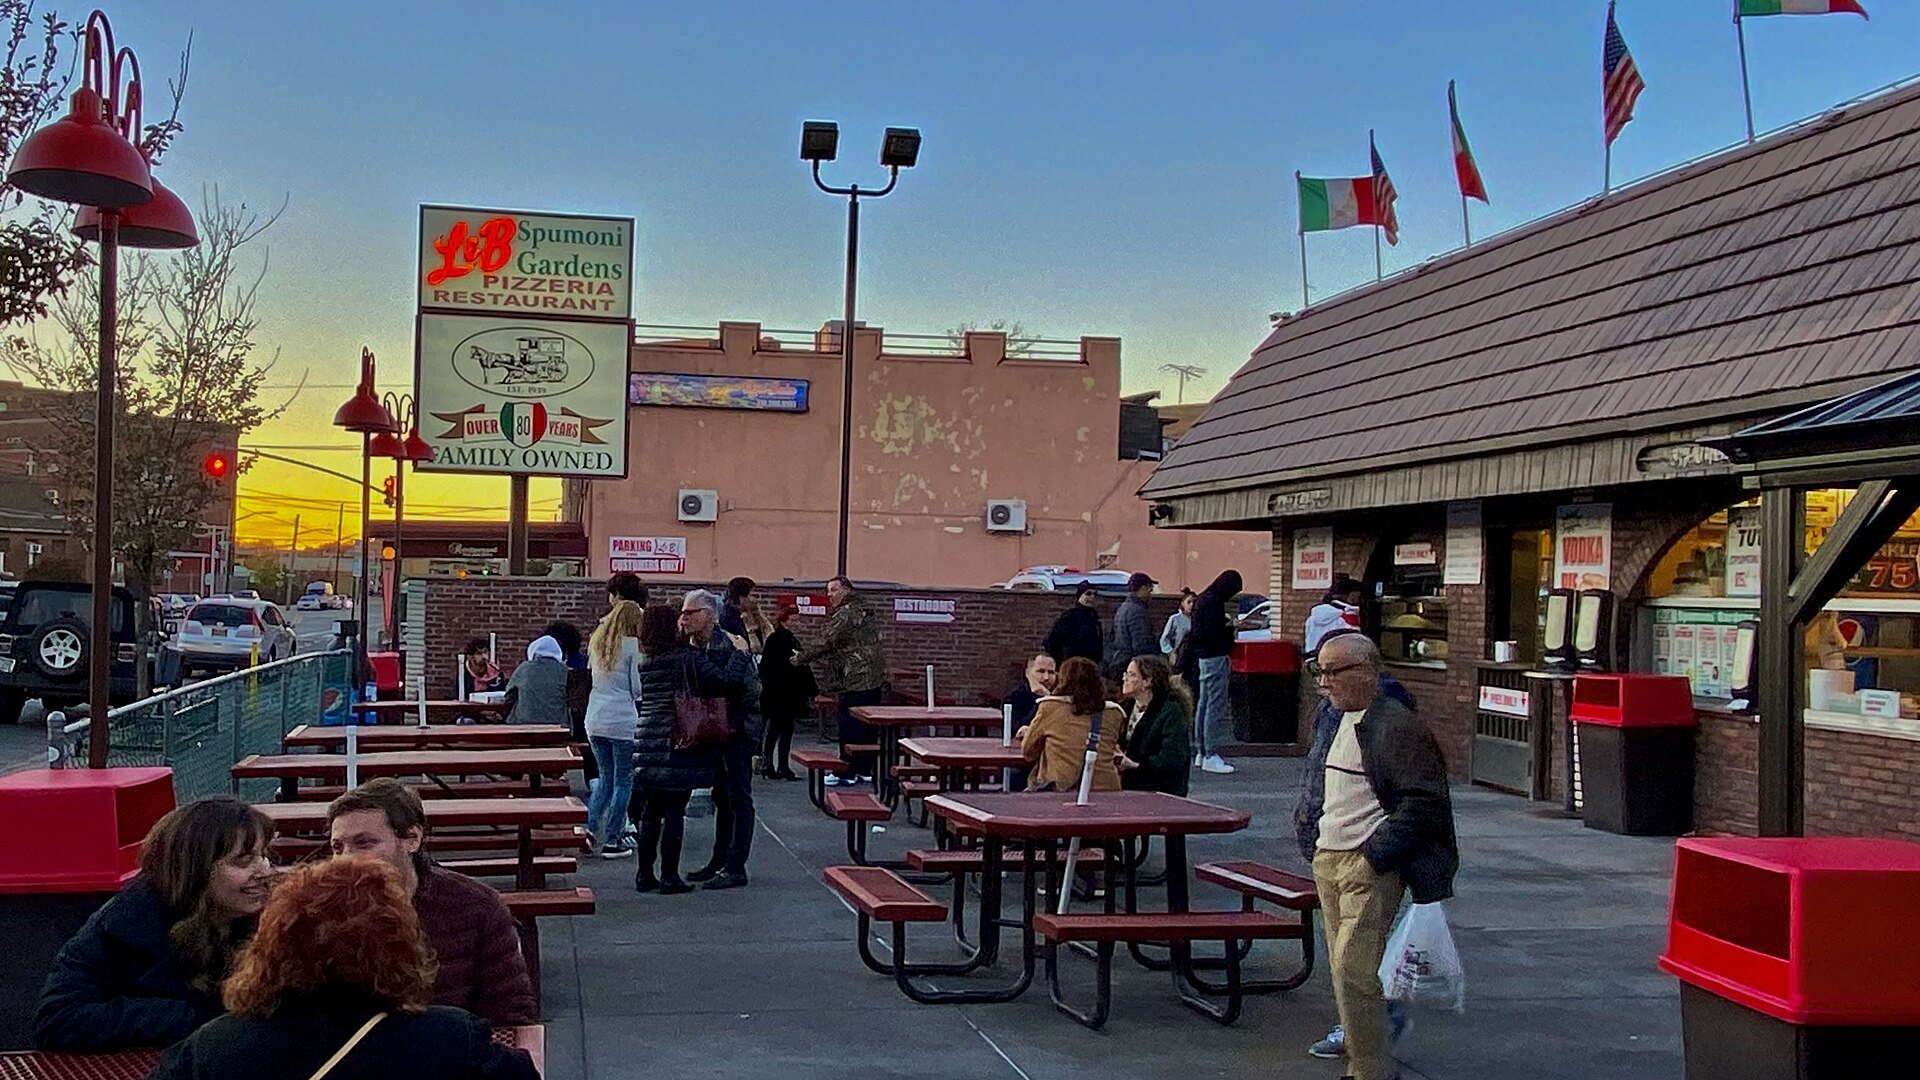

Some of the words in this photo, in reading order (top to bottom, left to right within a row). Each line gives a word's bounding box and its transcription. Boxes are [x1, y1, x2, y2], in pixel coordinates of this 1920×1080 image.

[518, 219, 623, 249] Spumoni
[517, 251, 622, 280] Gardens
[483, 275, 615, 296] PIZZERIA
[434, 289, 616, 312] RESTAURANT
[466, 419, 499, 436] OVER
[516, 415, 531, 436] 80
[549, 420, 579, 438] YEARS
[522, 449, 613, 471] OWNED
[613, 540, 652, 552] PARKING
[1562, 536, 1604, 566] VODKA
[894, 598, 956, 612] RESTROOMS
